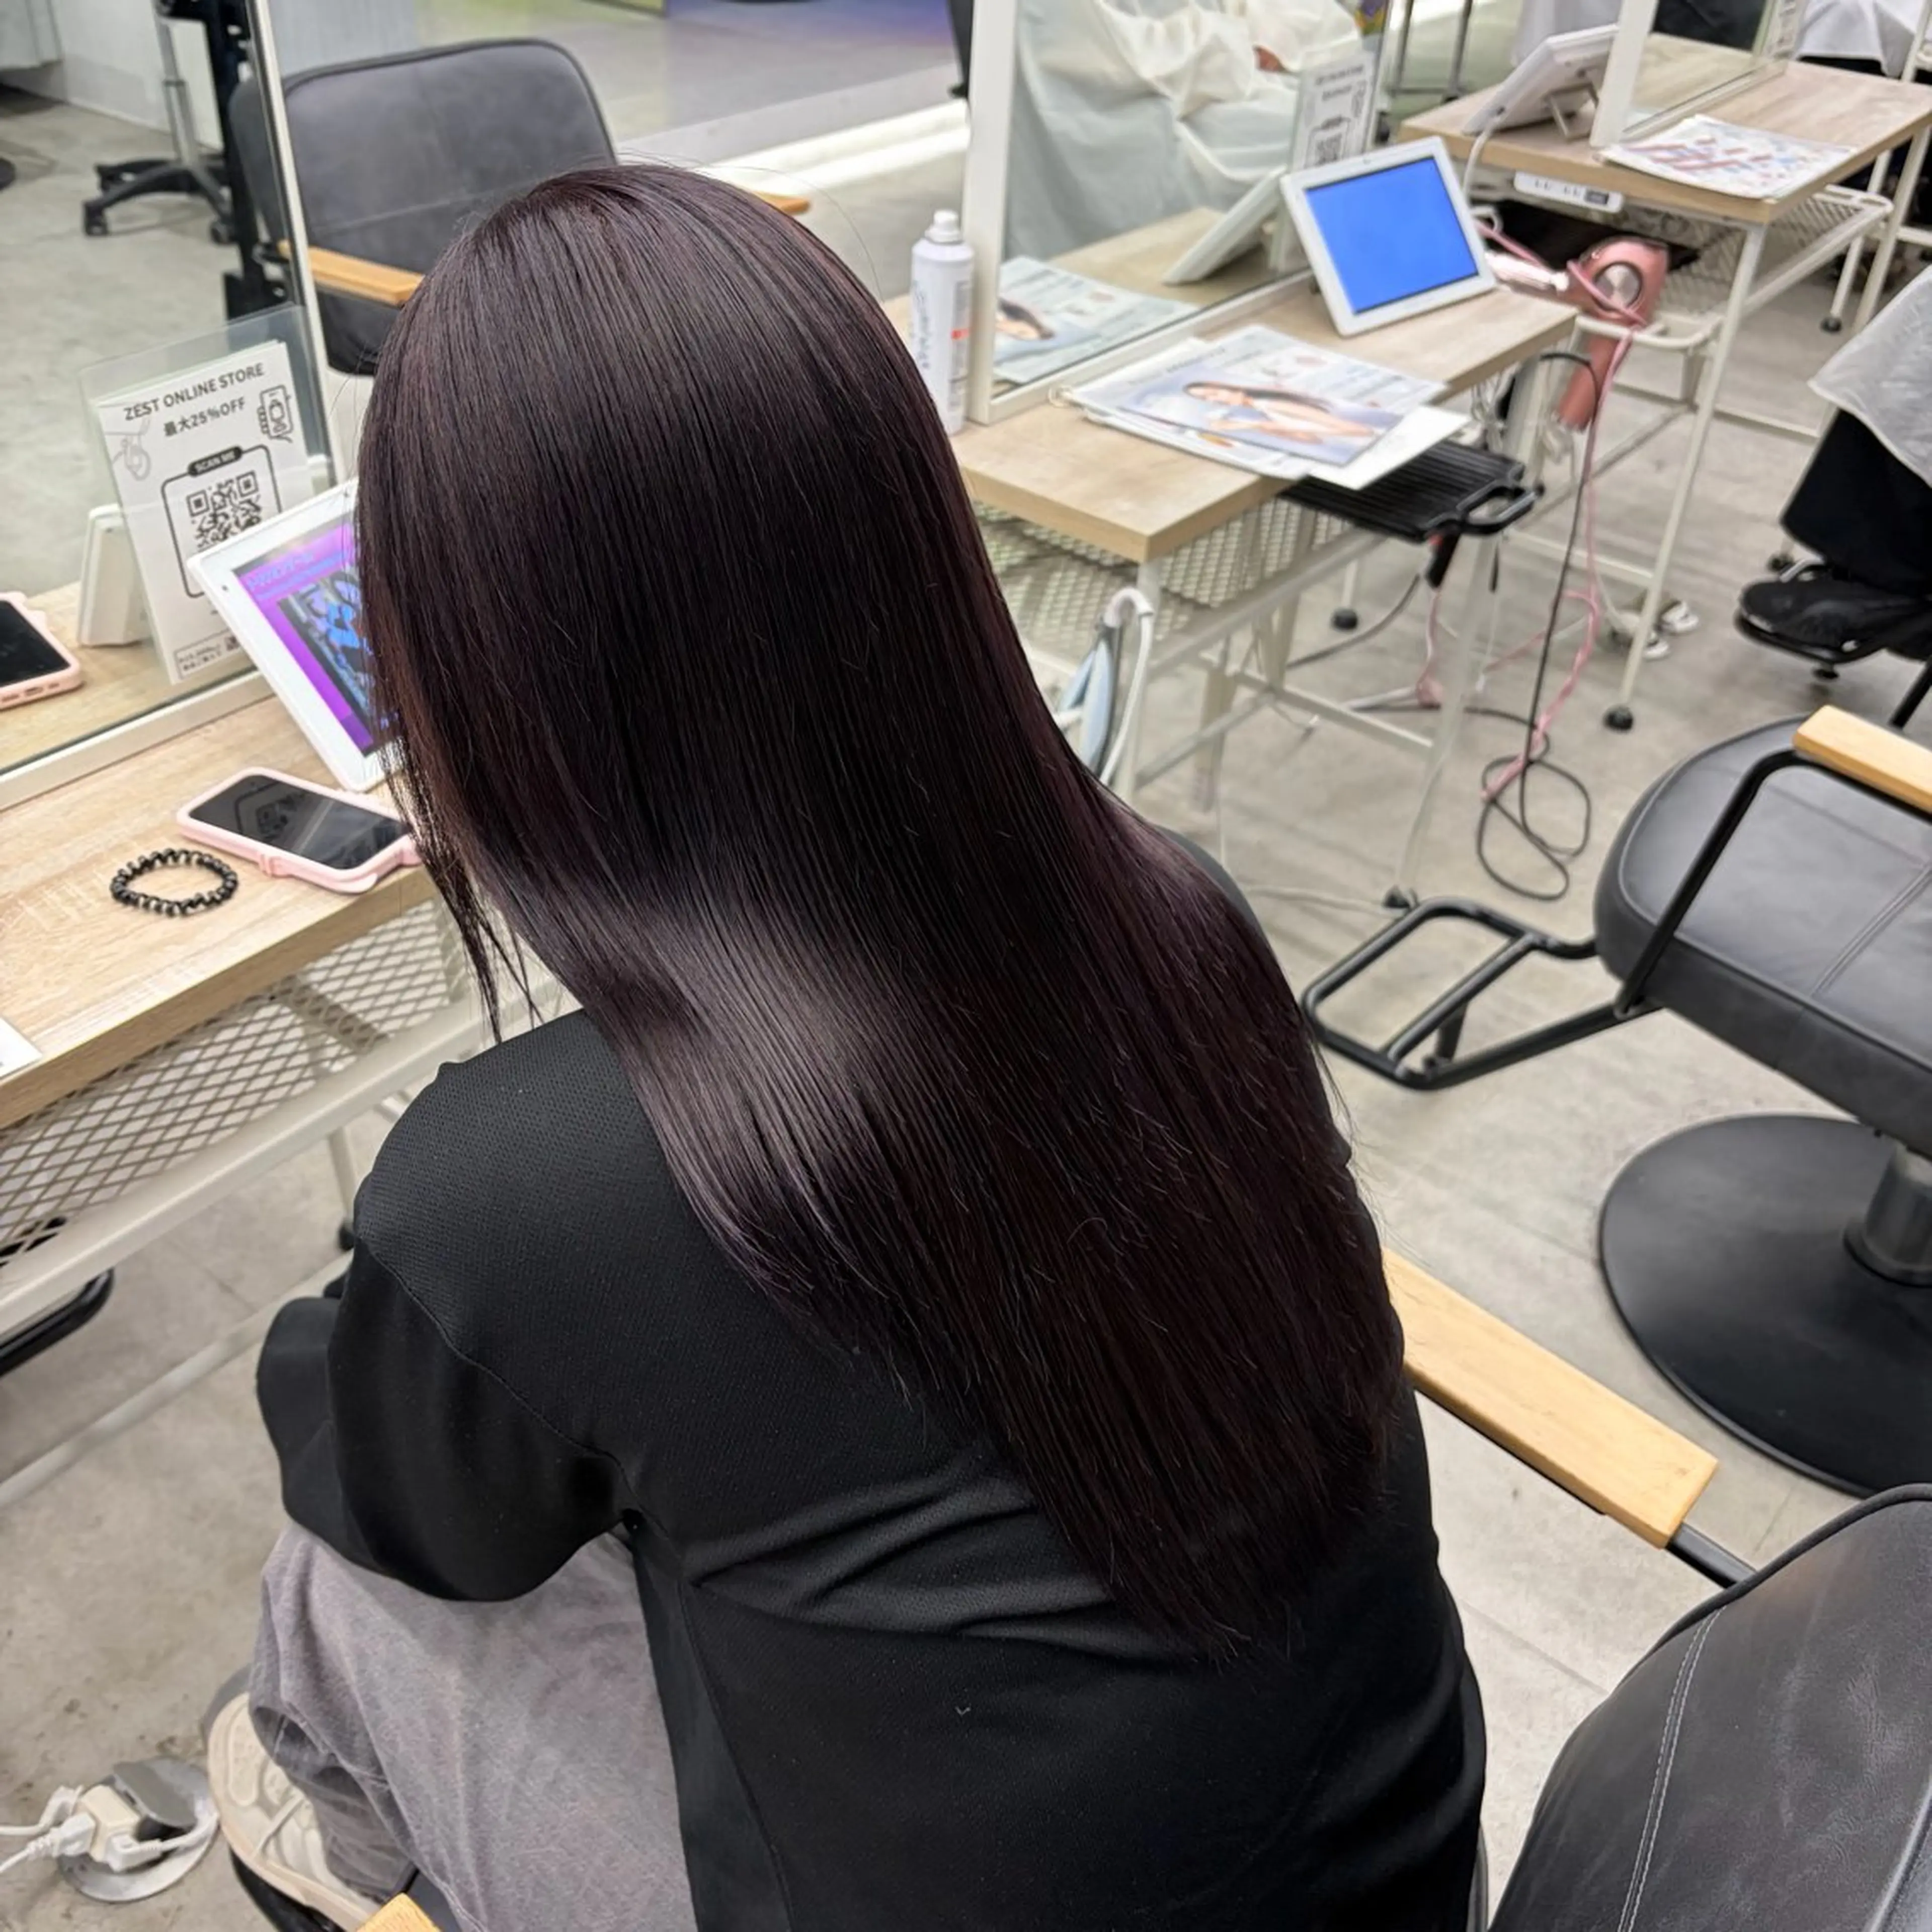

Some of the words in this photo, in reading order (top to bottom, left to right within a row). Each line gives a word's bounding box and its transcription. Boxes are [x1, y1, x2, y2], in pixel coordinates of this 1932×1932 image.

[124, 398, 159, 421] ZEST
[163, 379, 217, 407] ONLINE
[218, 362, 265, 388] STORE
